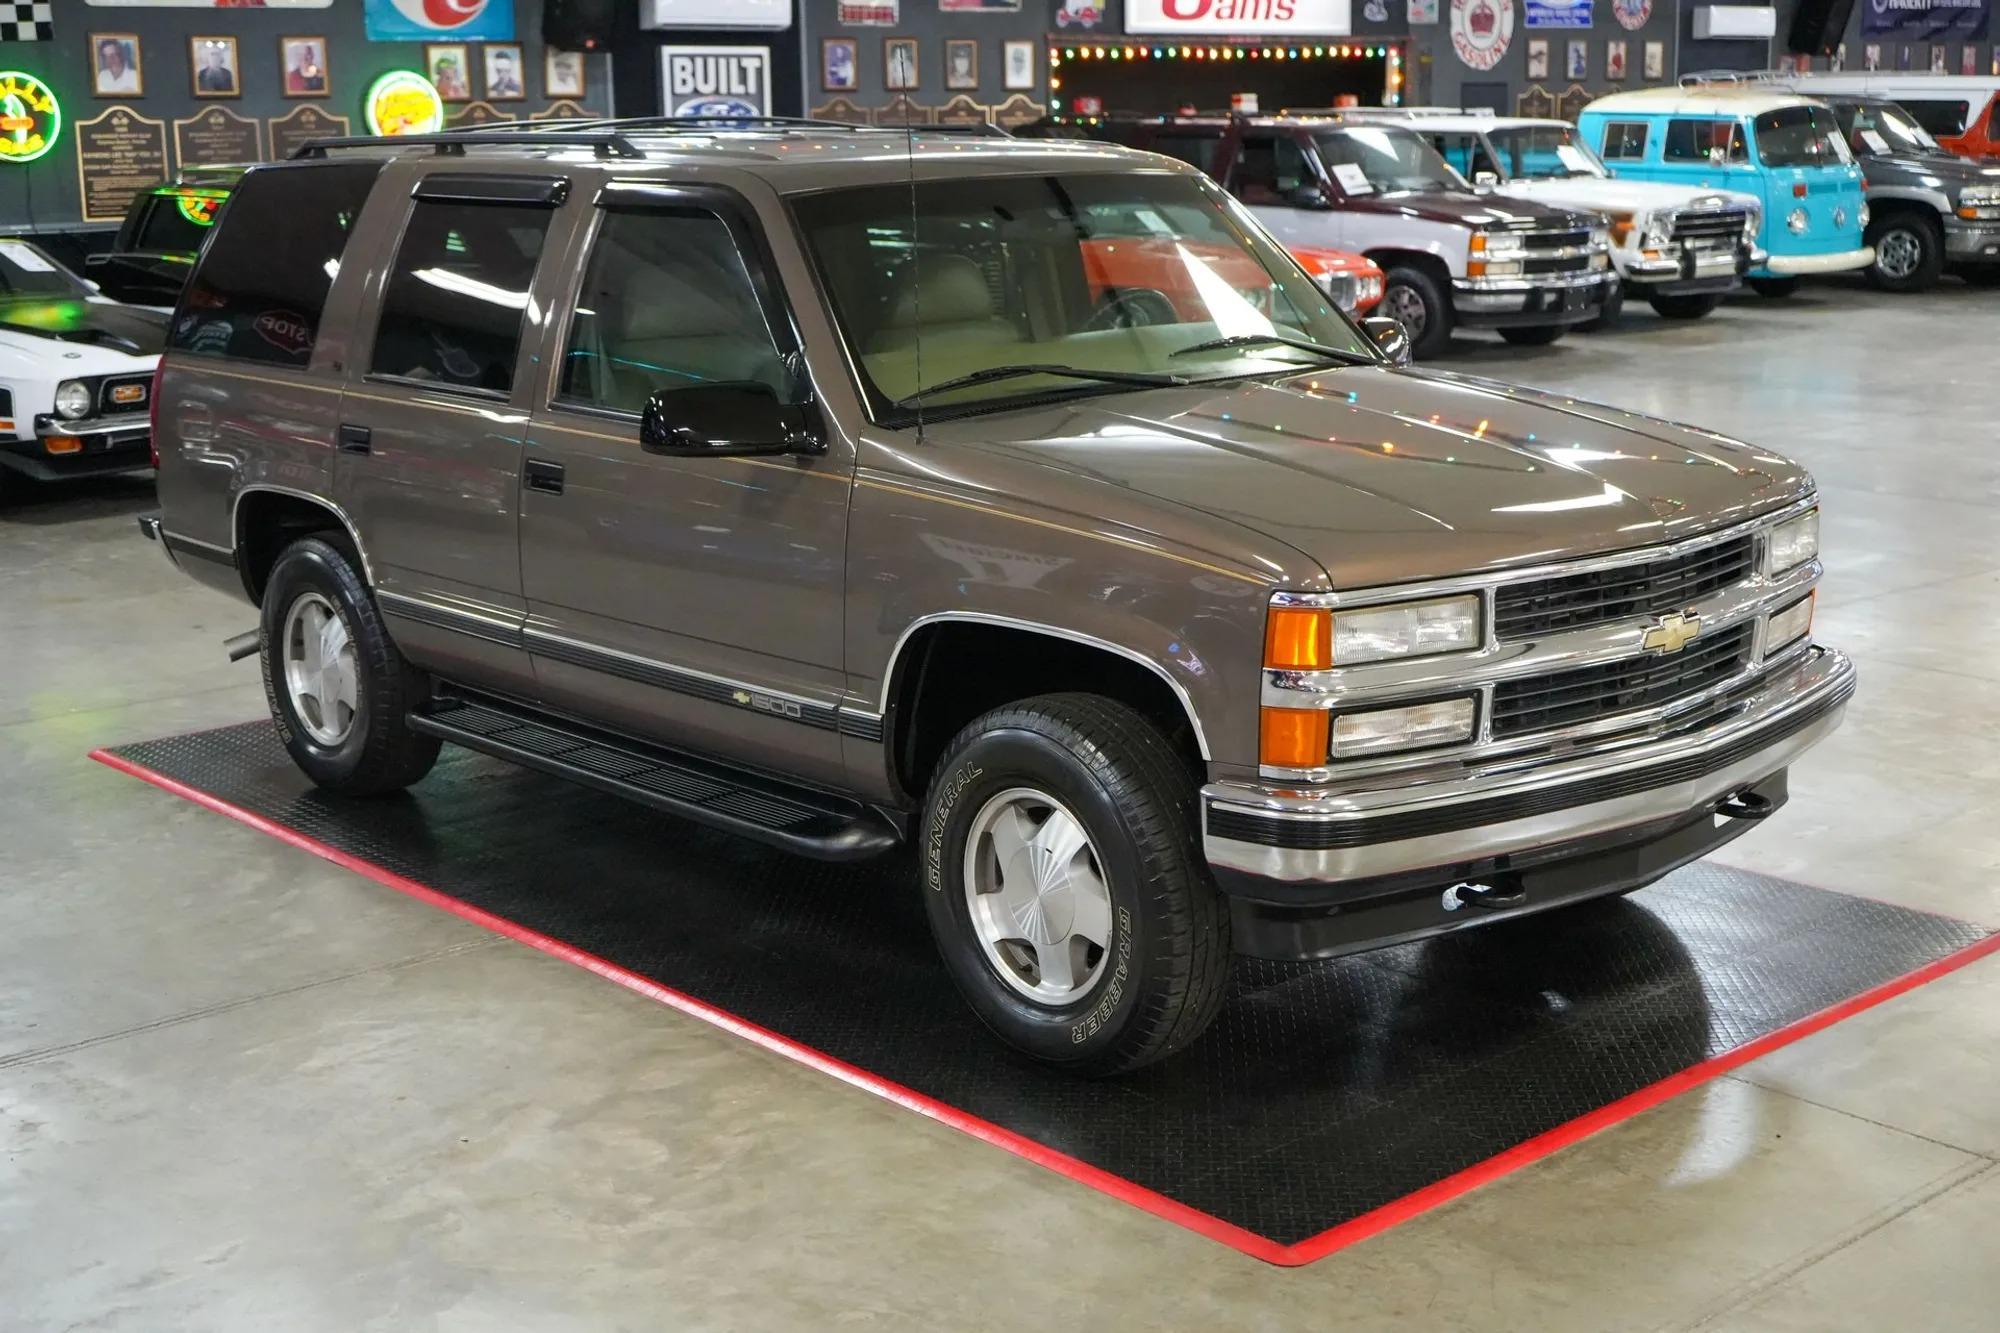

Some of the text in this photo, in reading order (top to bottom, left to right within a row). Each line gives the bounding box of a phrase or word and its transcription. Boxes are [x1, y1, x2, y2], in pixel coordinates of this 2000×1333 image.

[672, 57, 760, 95] BUILT
[928, 761, 983, 891] GENERAL
[1071, 906, 1132, 1043] GRABBER
